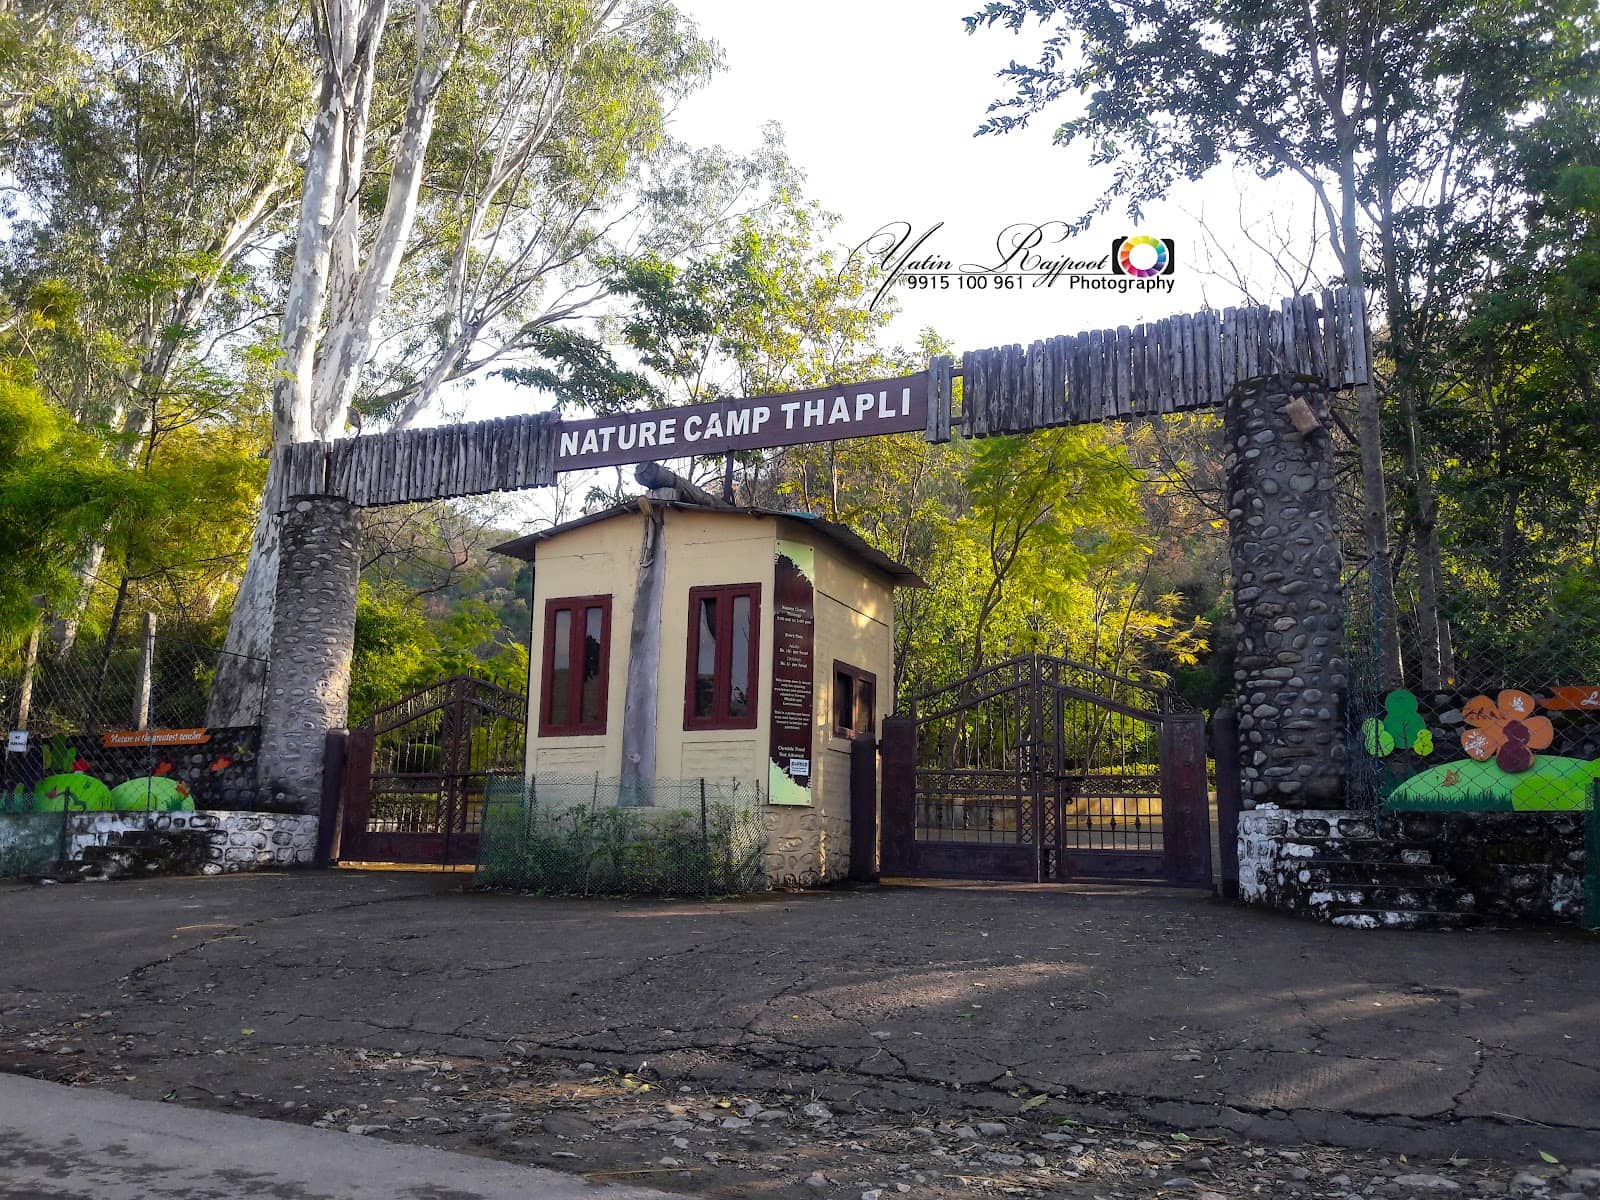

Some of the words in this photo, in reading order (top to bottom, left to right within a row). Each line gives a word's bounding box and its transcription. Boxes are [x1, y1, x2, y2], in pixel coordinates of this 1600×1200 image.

[559, 418, 676, 458] NATURE
[683, 406, 771, 443] CAMP
[781, 386, 911, 430] THAPLI
